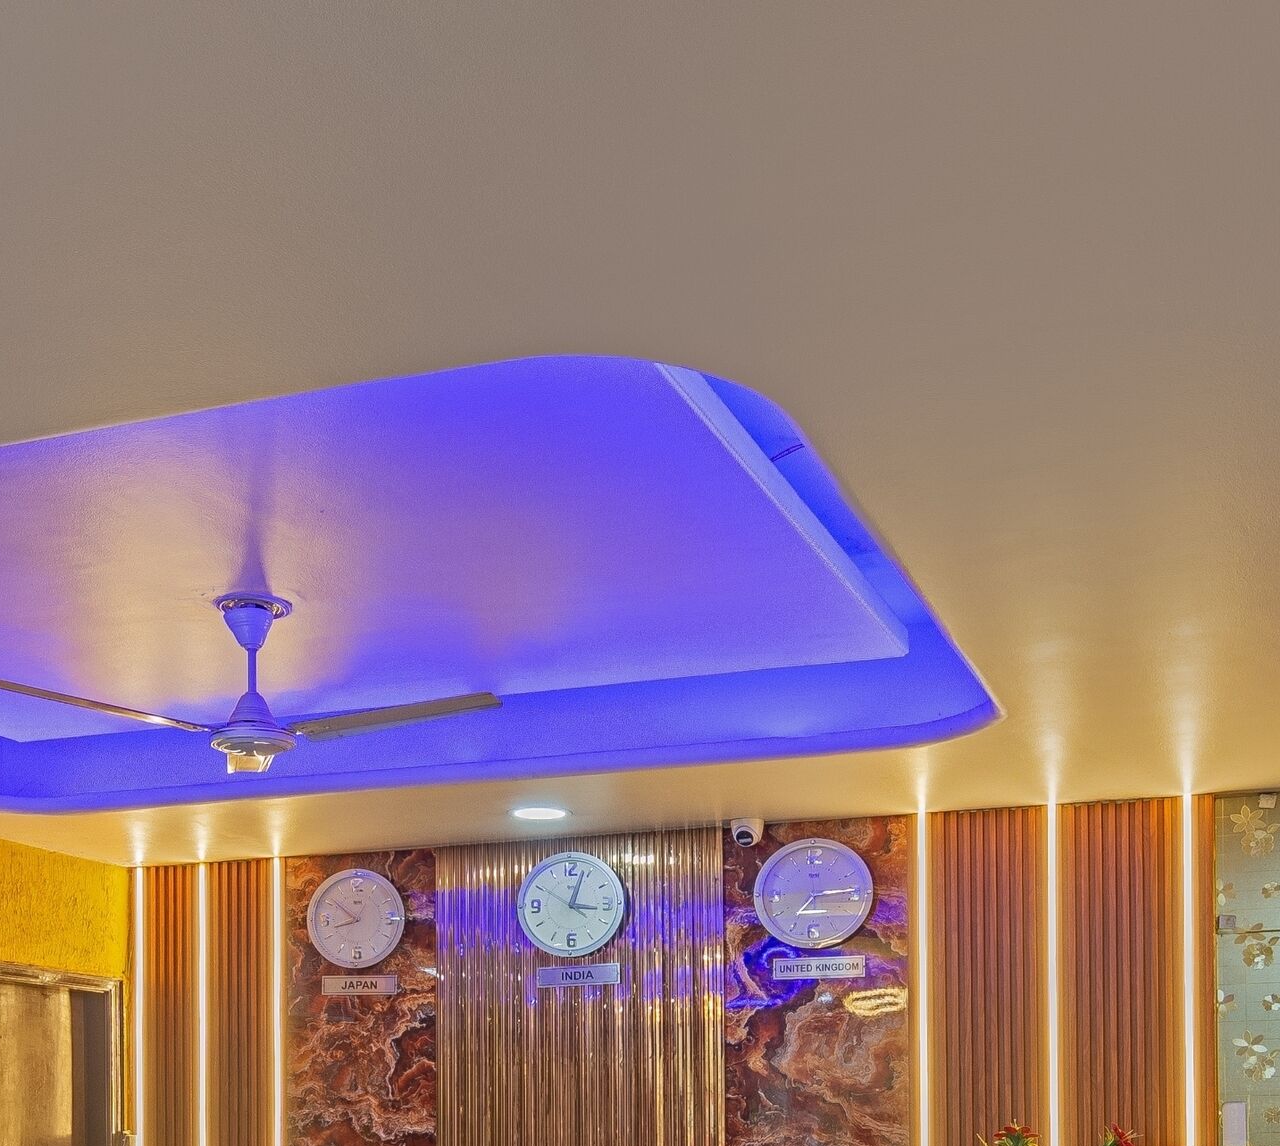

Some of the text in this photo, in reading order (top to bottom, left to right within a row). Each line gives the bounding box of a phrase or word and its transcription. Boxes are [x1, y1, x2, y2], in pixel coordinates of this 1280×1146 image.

[564, 862, 579, 877] 12
[531, 899, 541, 914] 9
[602, 896, 613, 911] 3
[566, 933, 577, 948] 6
[779, 962, 859, 973] UNITED KINGDOM
[561, 971, 594, 981] INDIA
[341, 981, 378, 990] JAPAN
